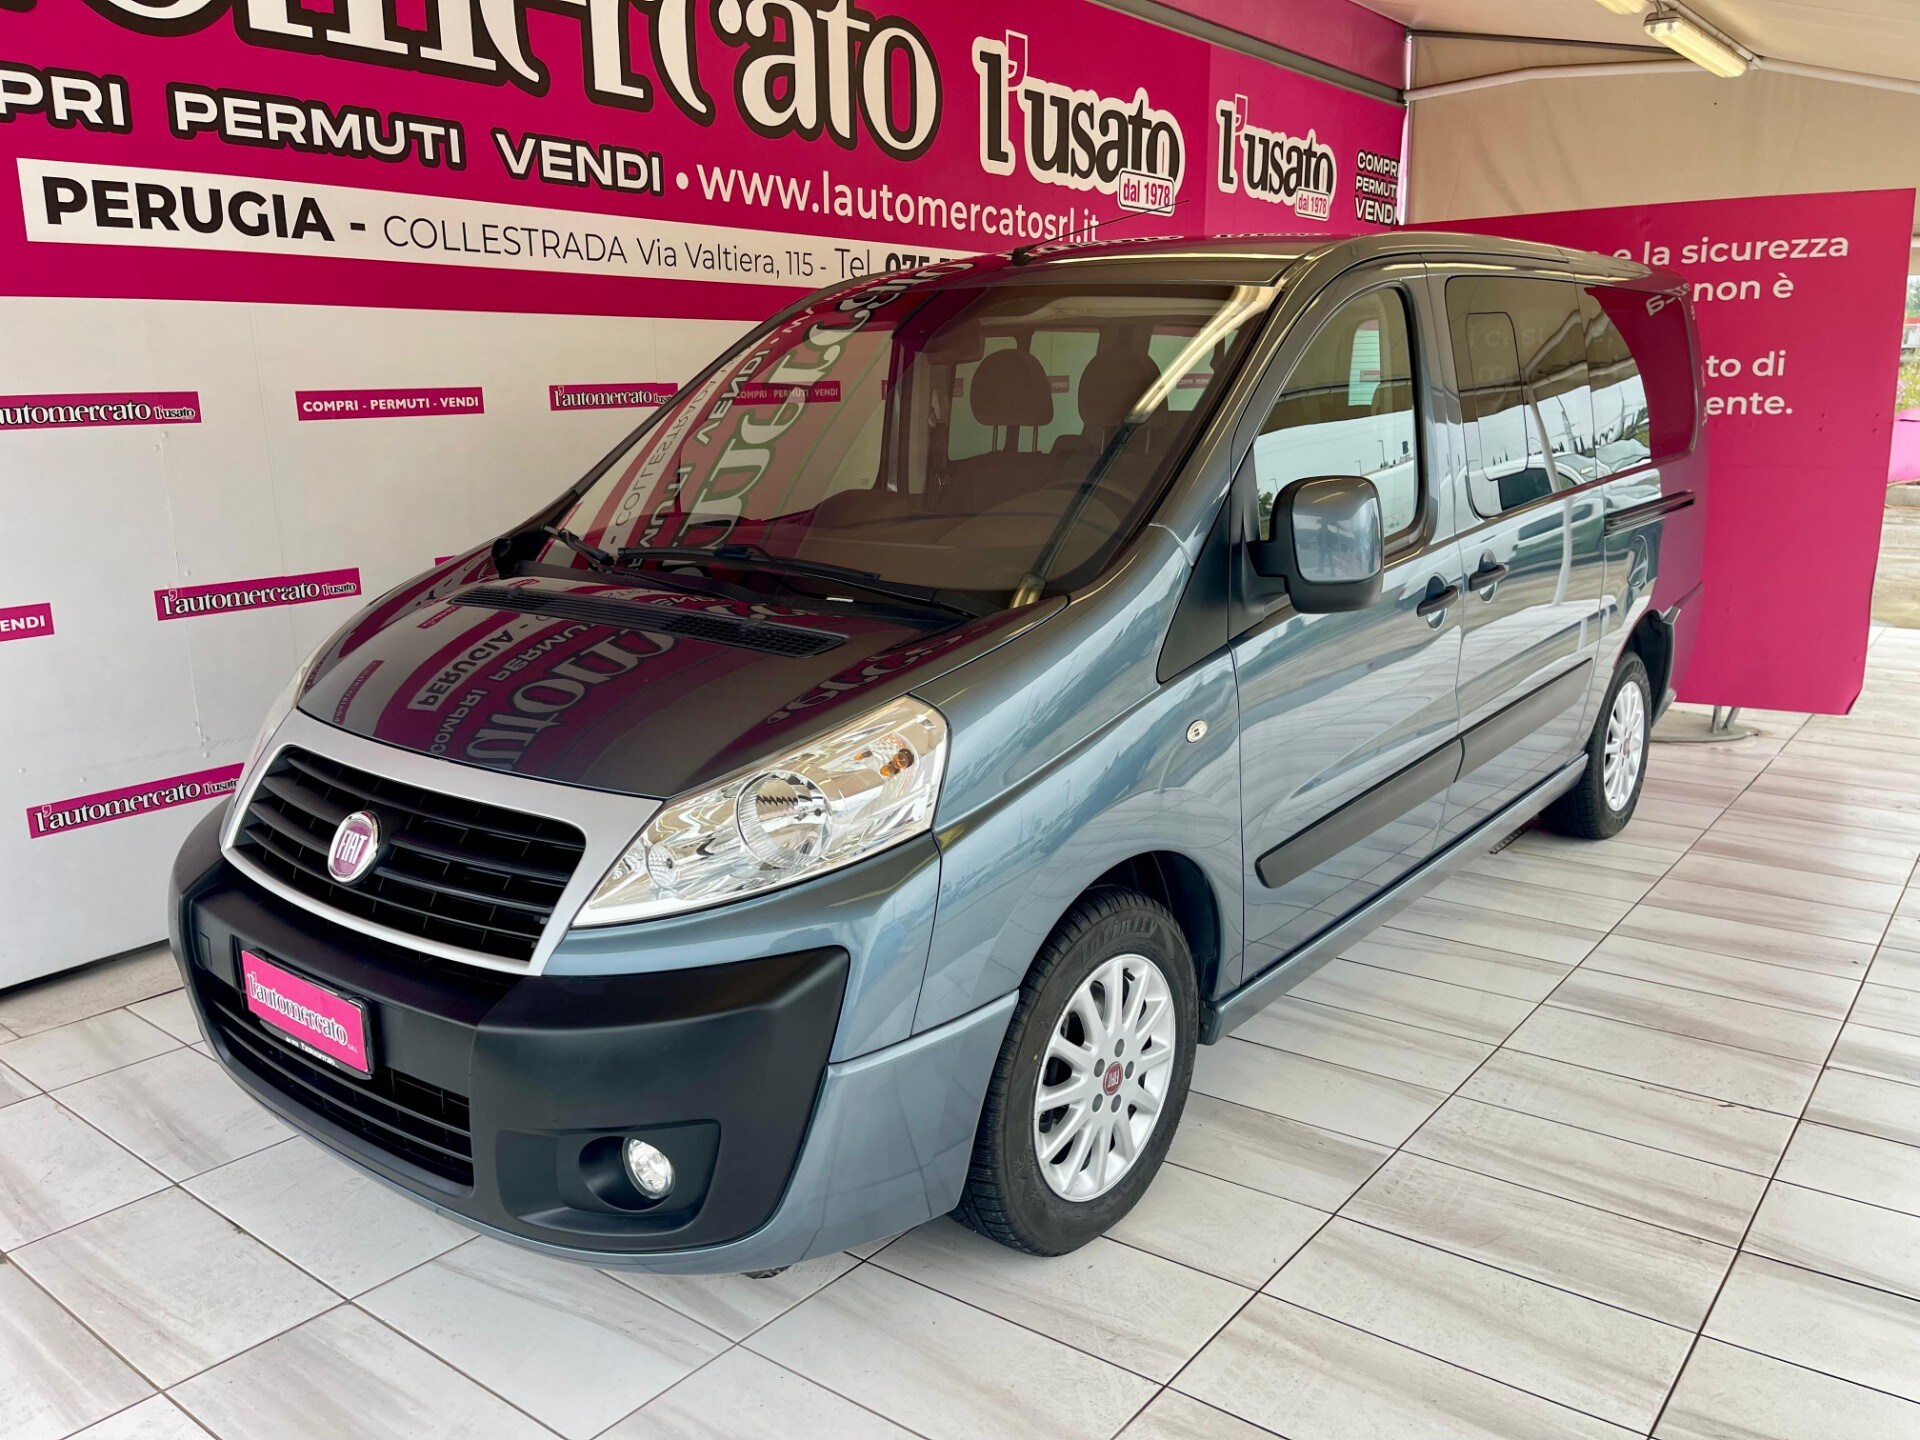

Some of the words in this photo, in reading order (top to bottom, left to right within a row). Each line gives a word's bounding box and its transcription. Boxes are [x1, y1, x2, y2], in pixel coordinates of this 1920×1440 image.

[974, 29, 1183, 187] l'usato
[1217, 93, 1336, 199] l'usato
[172, 88, 463, 166] PERMUTI
[494, 130, 662, 194] VENDI
[696, 163, 1101, 243] www.lautomercatosrl.it
[1122, 178, 1141, 203] dal
[1143, 180, 1171, 207] 1978
[1310, 196, 1328, 215] 1978
[42, 175, 335, 242] PERUGIA
[384, 215, 628, 264] COLLESTRADA
[636, 237, 677, 268] Via
[684, 241, 781, 279] Valtiera,
[785, 250, 814, 277] 115
[1643, 241, 1671, 266] la
[1681, 236, 1849, 265] sicurezza
[1693, 280, 1761, 302] non
[1772, 272, 1795, 299] è
[1752, 350, 1787, 377] di
[302, 400, 359, 413] COMPRI
[370, 398, 430, 411] PERMUTI
[439, 396, 479, 409] VENDI
[554, 385, 653, 408] l'automercato
[0, 614, 46, 632] ENDI
[32, 781, 201, 832] l'automercato
[336, 828, 369, 865] FIAT
[246, 971, 348, 1046] l'automercato
